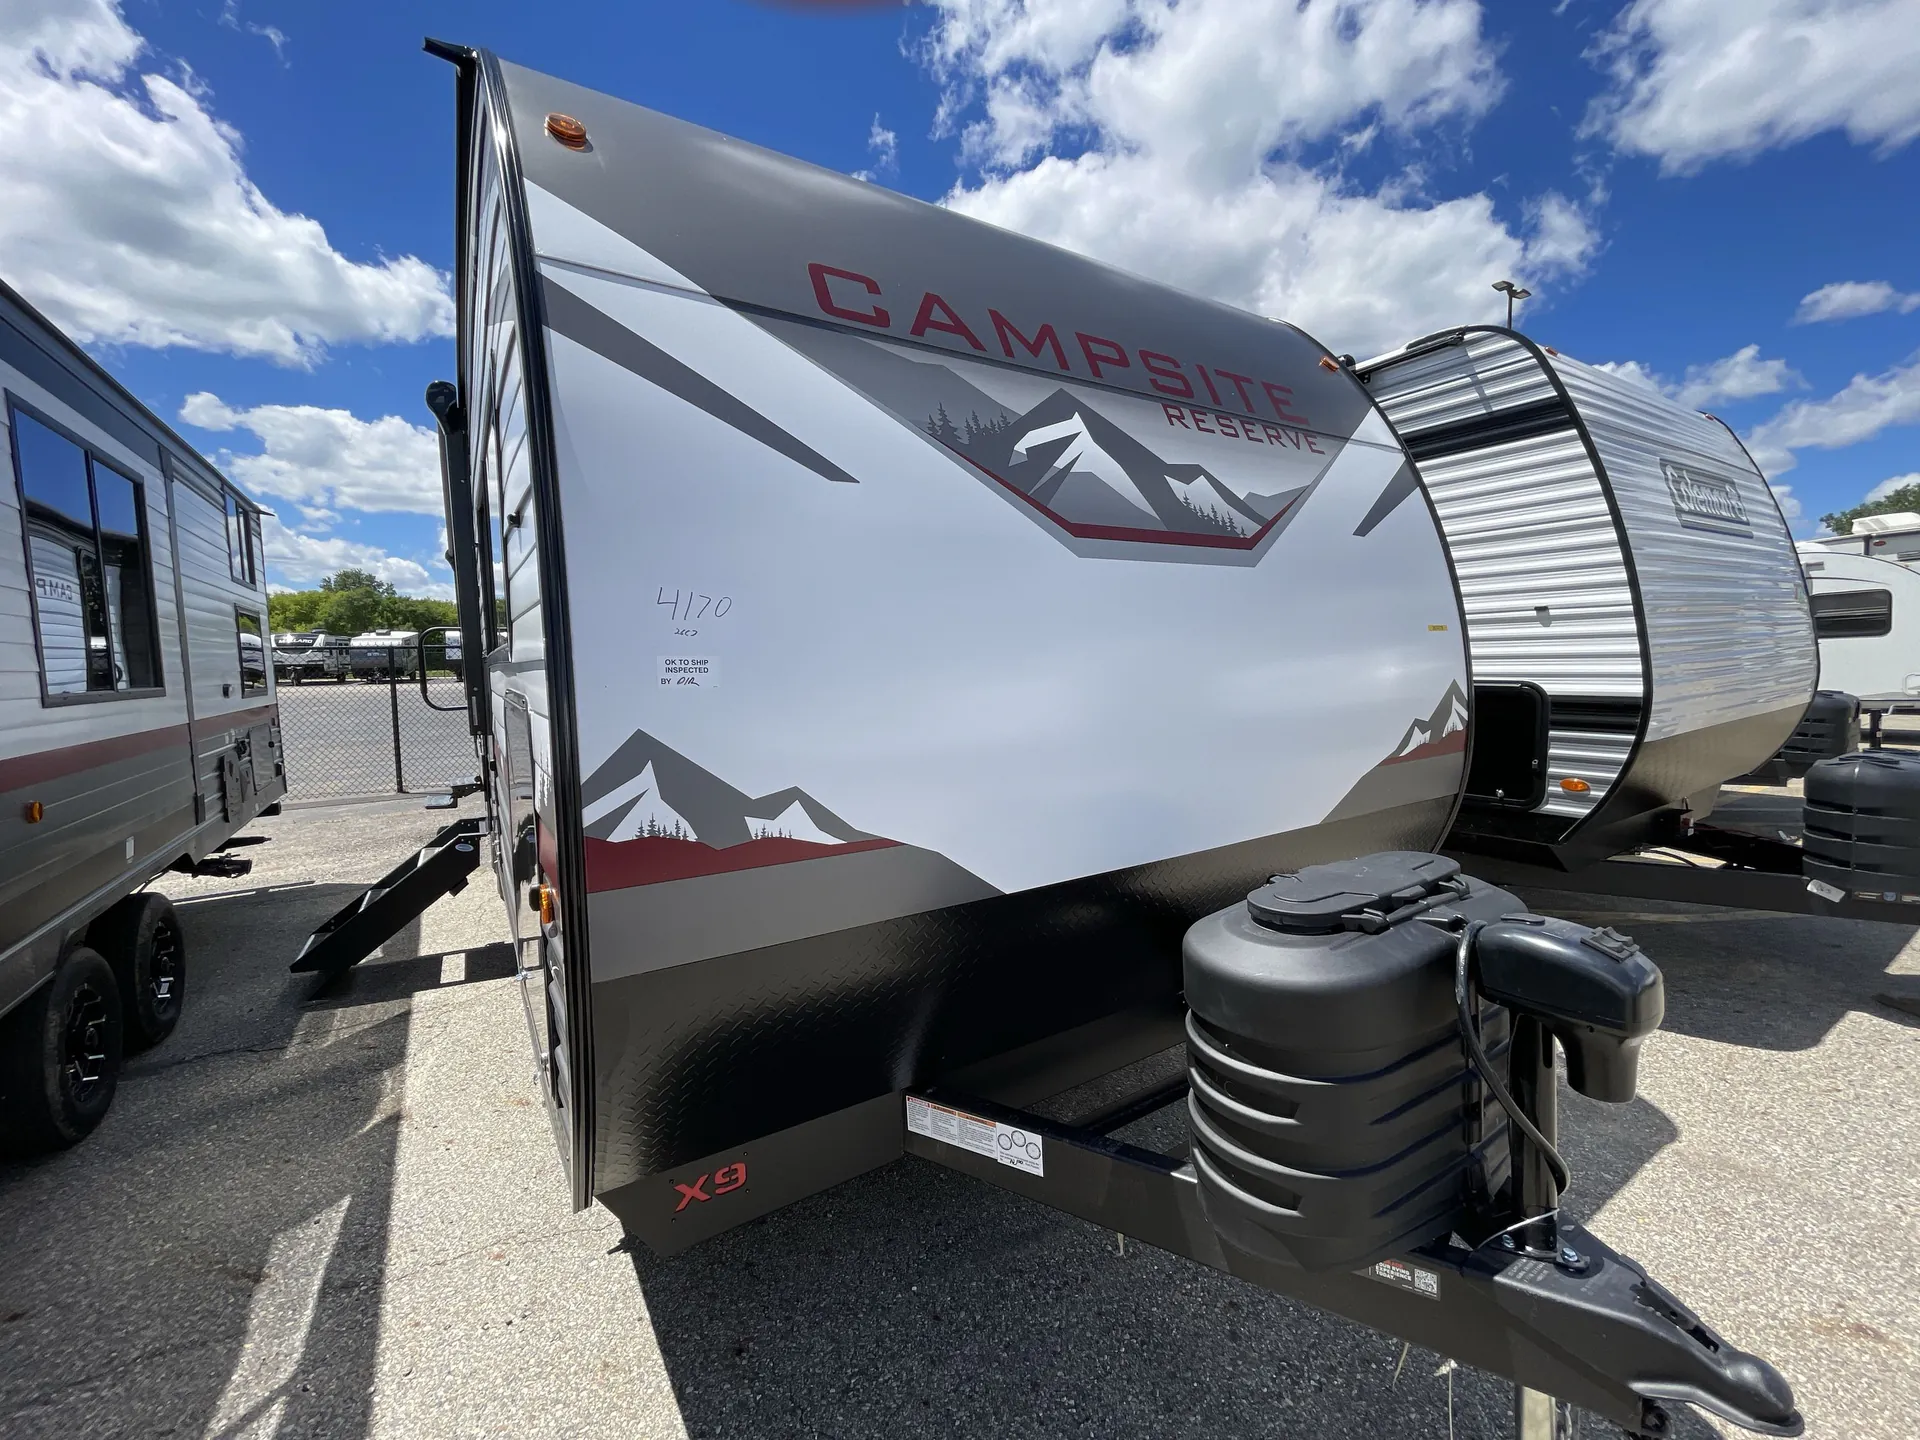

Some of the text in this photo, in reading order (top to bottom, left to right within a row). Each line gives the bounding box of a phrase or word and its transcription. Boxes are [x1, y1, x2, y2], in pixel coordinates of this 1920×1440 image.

[807, 262, 1311, 426] CAMPSITE
[1160, 402, 1326, 456] RESERVE
[657, 586, 732, 621] 4170
[664, 658, 677, 666] OK
[665, 666, 709, 674] INSPECTED
[673, 1162, 747, 1213] X9
